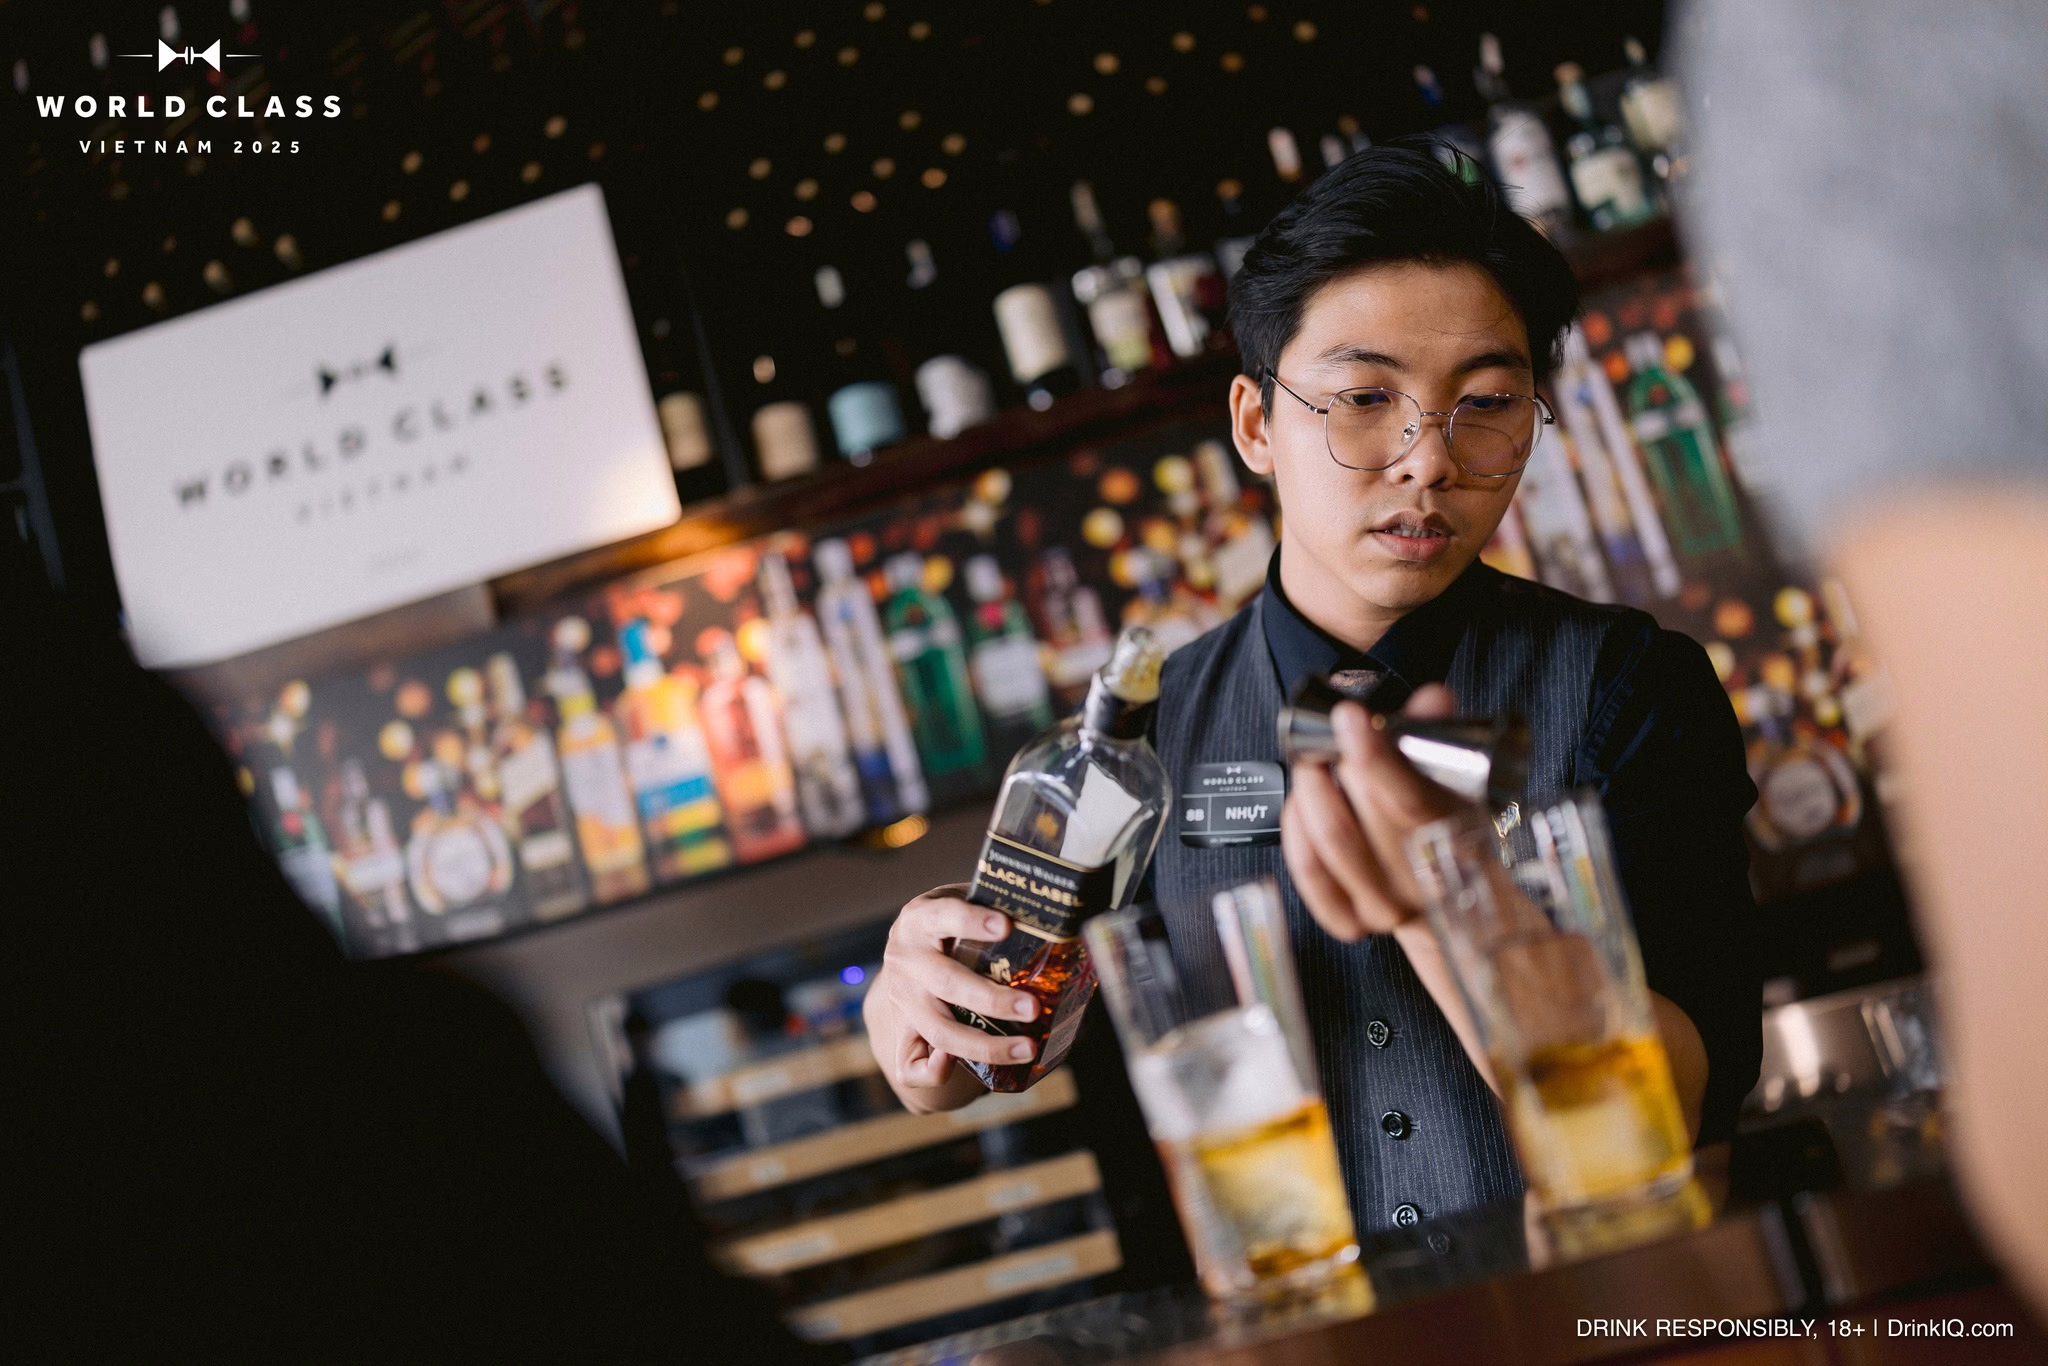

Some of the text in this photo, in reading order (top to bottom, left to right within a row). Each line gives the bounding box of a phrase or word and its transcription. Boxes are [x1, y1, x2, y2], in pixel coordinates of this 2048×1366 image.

[173, 356, 569, 512] WORLD CLASS
[1029, 880, 1084, 907] LABEL
